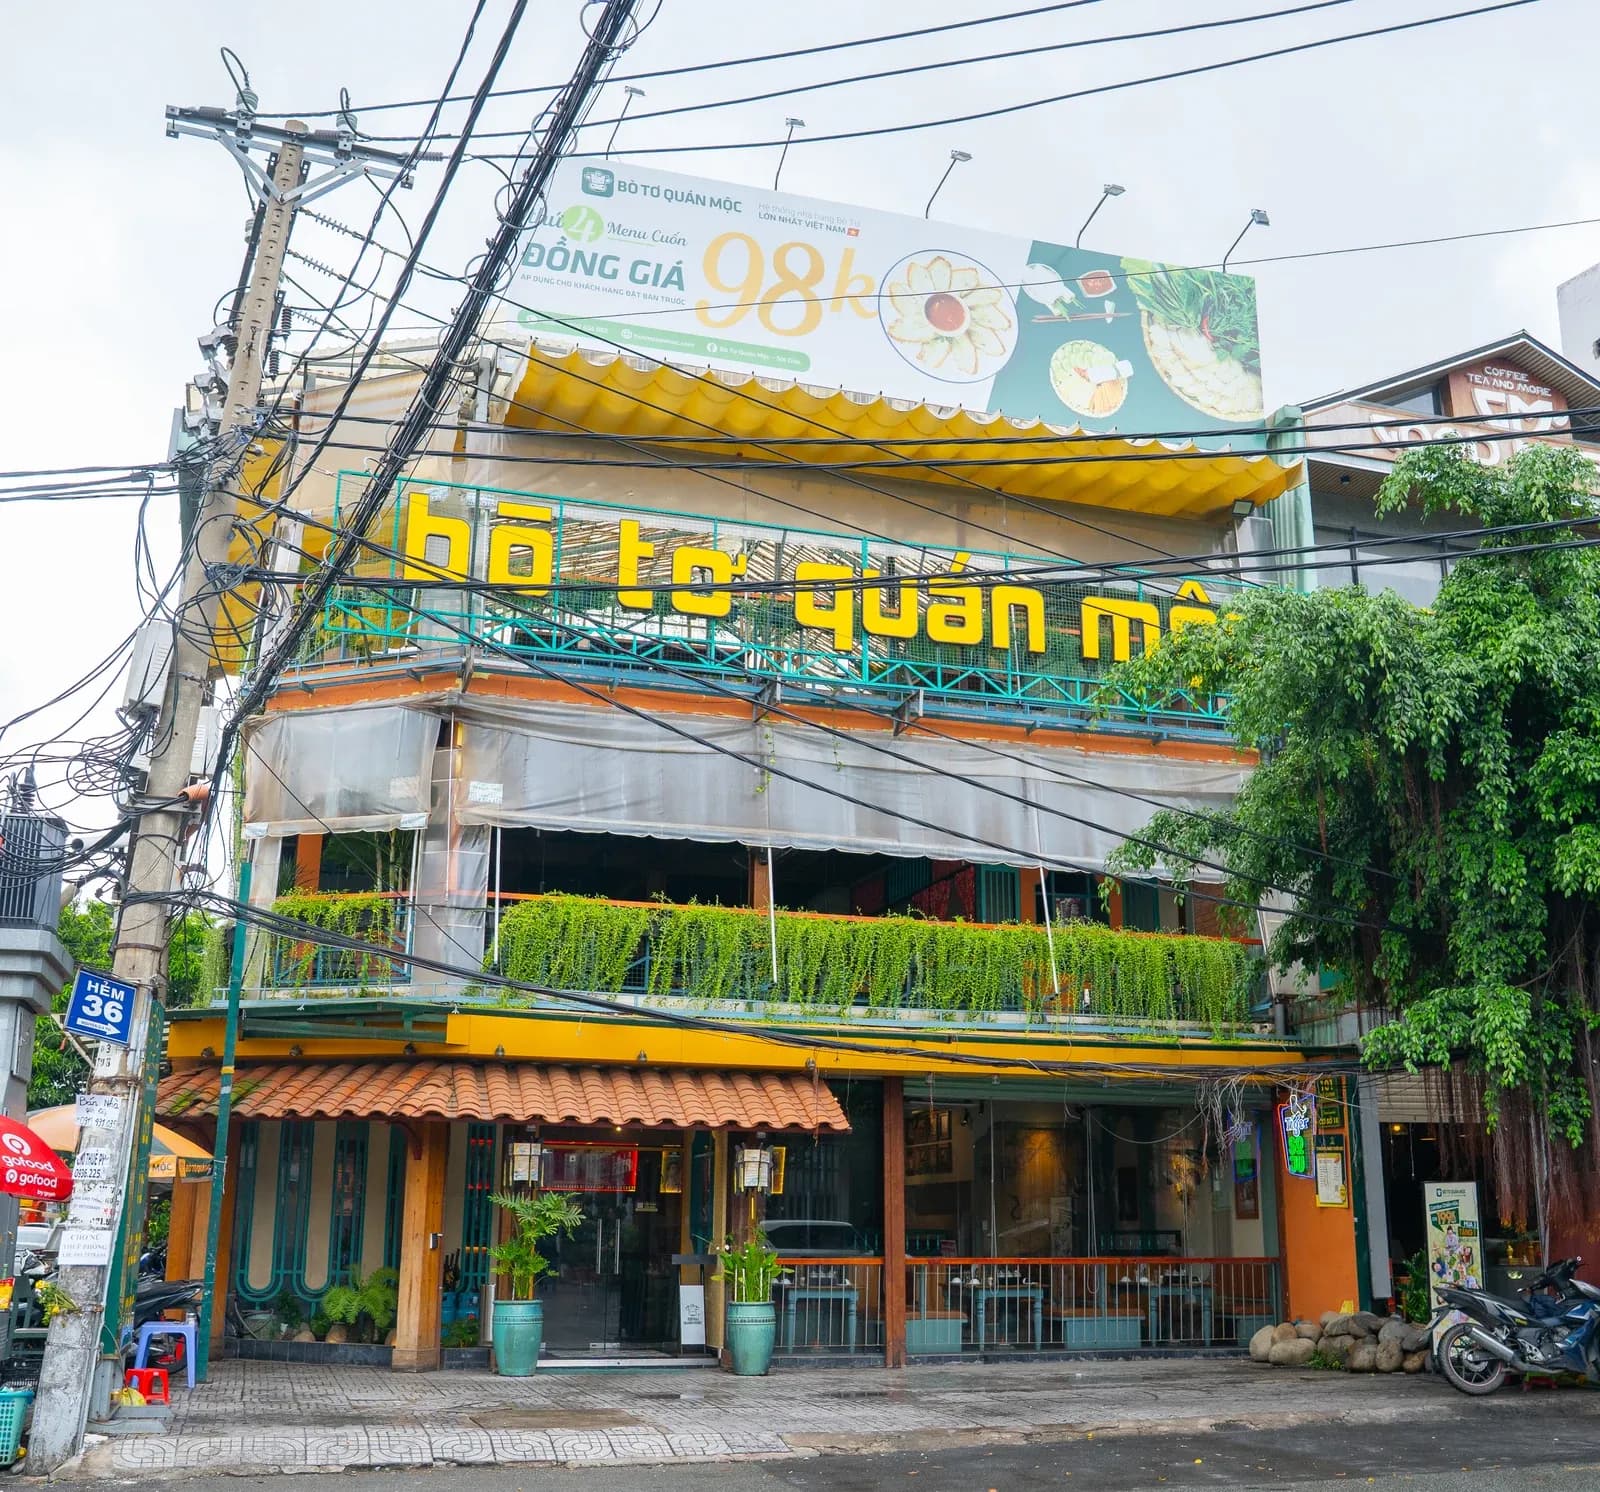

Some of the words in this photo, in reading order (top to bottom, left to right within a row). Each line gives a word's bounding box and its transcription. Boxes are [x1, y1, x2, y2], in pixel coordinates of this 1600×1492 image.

[617, 179, 638, 194] BÒ
[640, 184, 661, 198] TƠ
[663, 189, 706, 206] QUÁN
[709, 196, 742, 214] MỘC
[567, 207, 597, 242] 4
[607, 221, 648, 239] Menu
[651, 229, 688, 246] Cuốn
[825, 223, 846, 234] NAM
[521, 236, 620, 280] ĐỒNG
[628, 259, 686, 292] GIÁ
[556, 278, 573, 288] CHO
[1467, 373, 1490, 385] TEA
[1492, 378, 1515, 391] AND
[1516, 383, 1553, 397] MORE
[1484, 366, 1529, 382] COFFEE
[794, 551, 1046, 654] quán
[86, 979, 125, 1002] HẺM
[81, 994, 123, 1023] 36
[1285, 1113, 1310, 1137] Tiger
[2, 1155, 55, 1172] gofood
[19, 1174, 57, 1188] gofood
